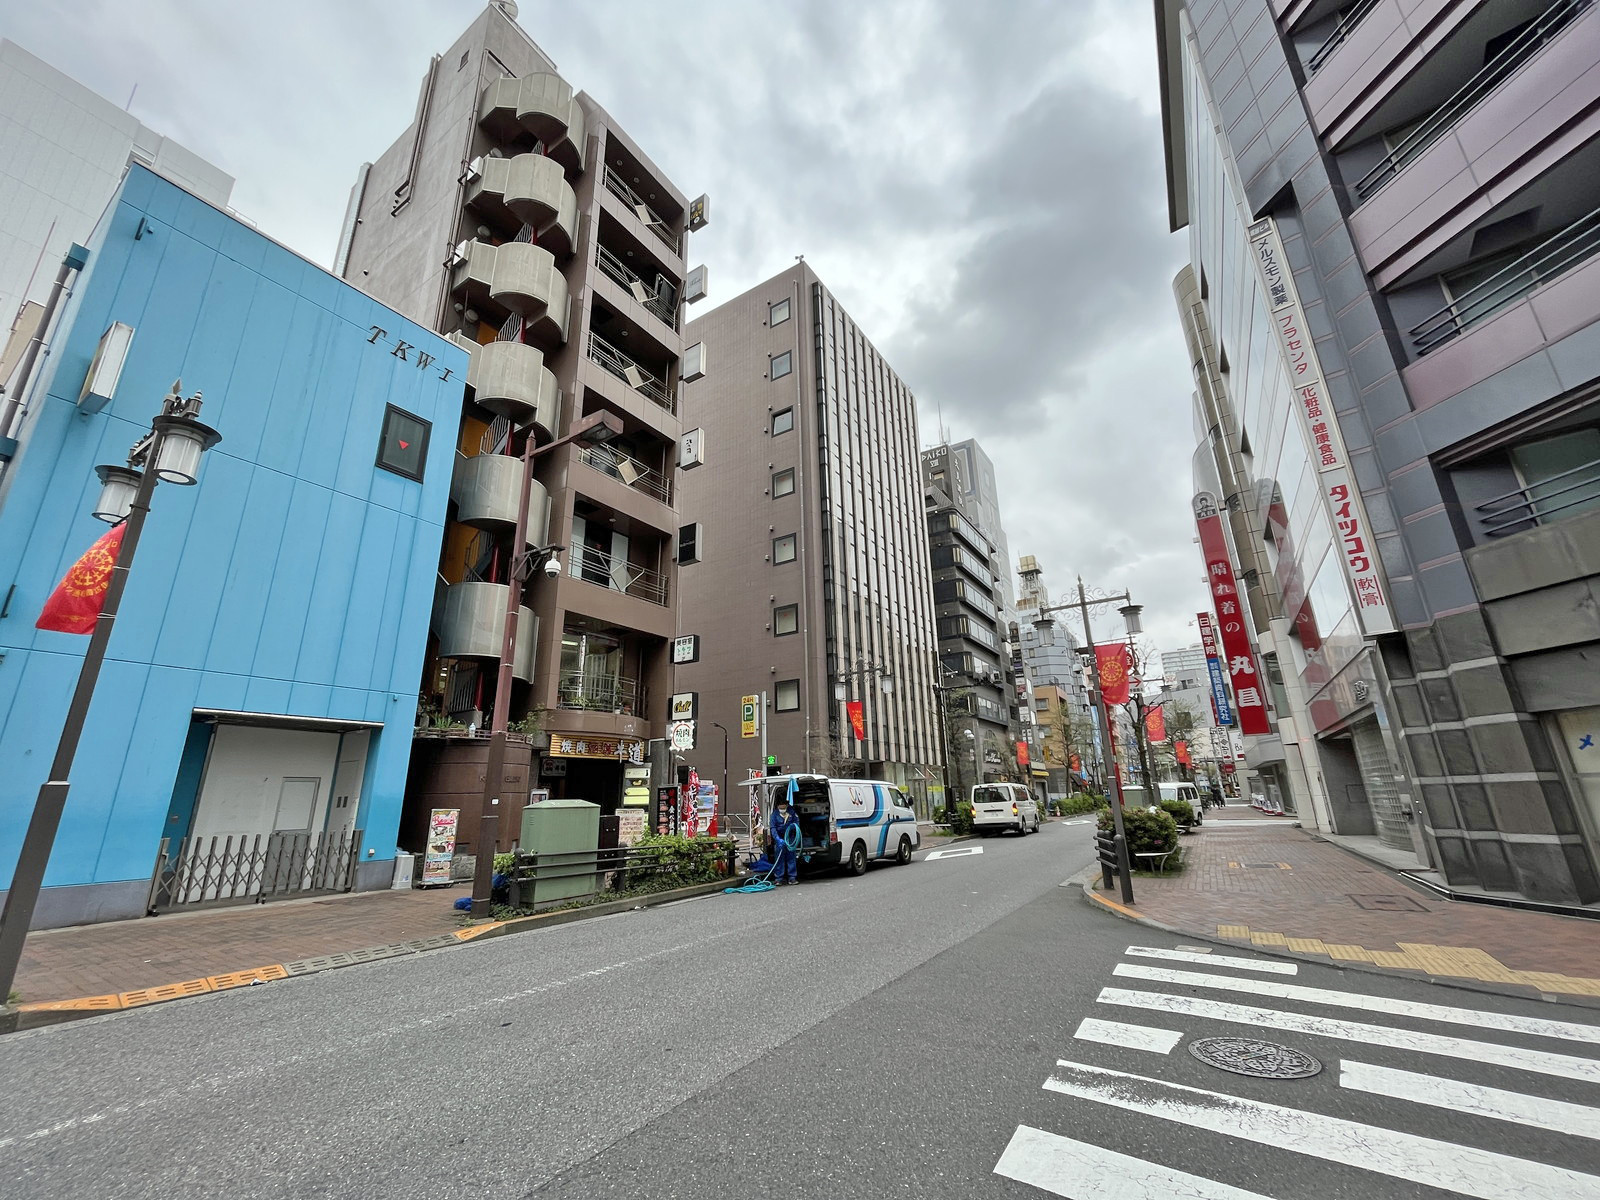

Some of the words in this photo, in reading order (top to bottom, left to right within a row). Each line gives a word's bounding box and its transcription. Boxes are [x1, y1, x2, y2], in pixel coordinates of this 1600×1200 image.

[1258, 238, 1289, 307] メルスモン製薬
[366, 325, 454, 383] TKWI
[1279, 314, 1308, 375] プラセンタ
[921, 447, 947, 462] DAIKO
[1301, 387, 1337, 467] 化粧品・健康食品
[1329, 484, 1371, 573] タイツコウ
[1357, 577, 1379, 606] 軟膏
[1211, 561, 1240, 633] 晴れ着の
[1230, 655, 1263, 708] 丸昌
[675, 728, 690, 738] 焼肉
[744, 704, 753, 721] P
[561, 739, 586, 754] 焼肉
